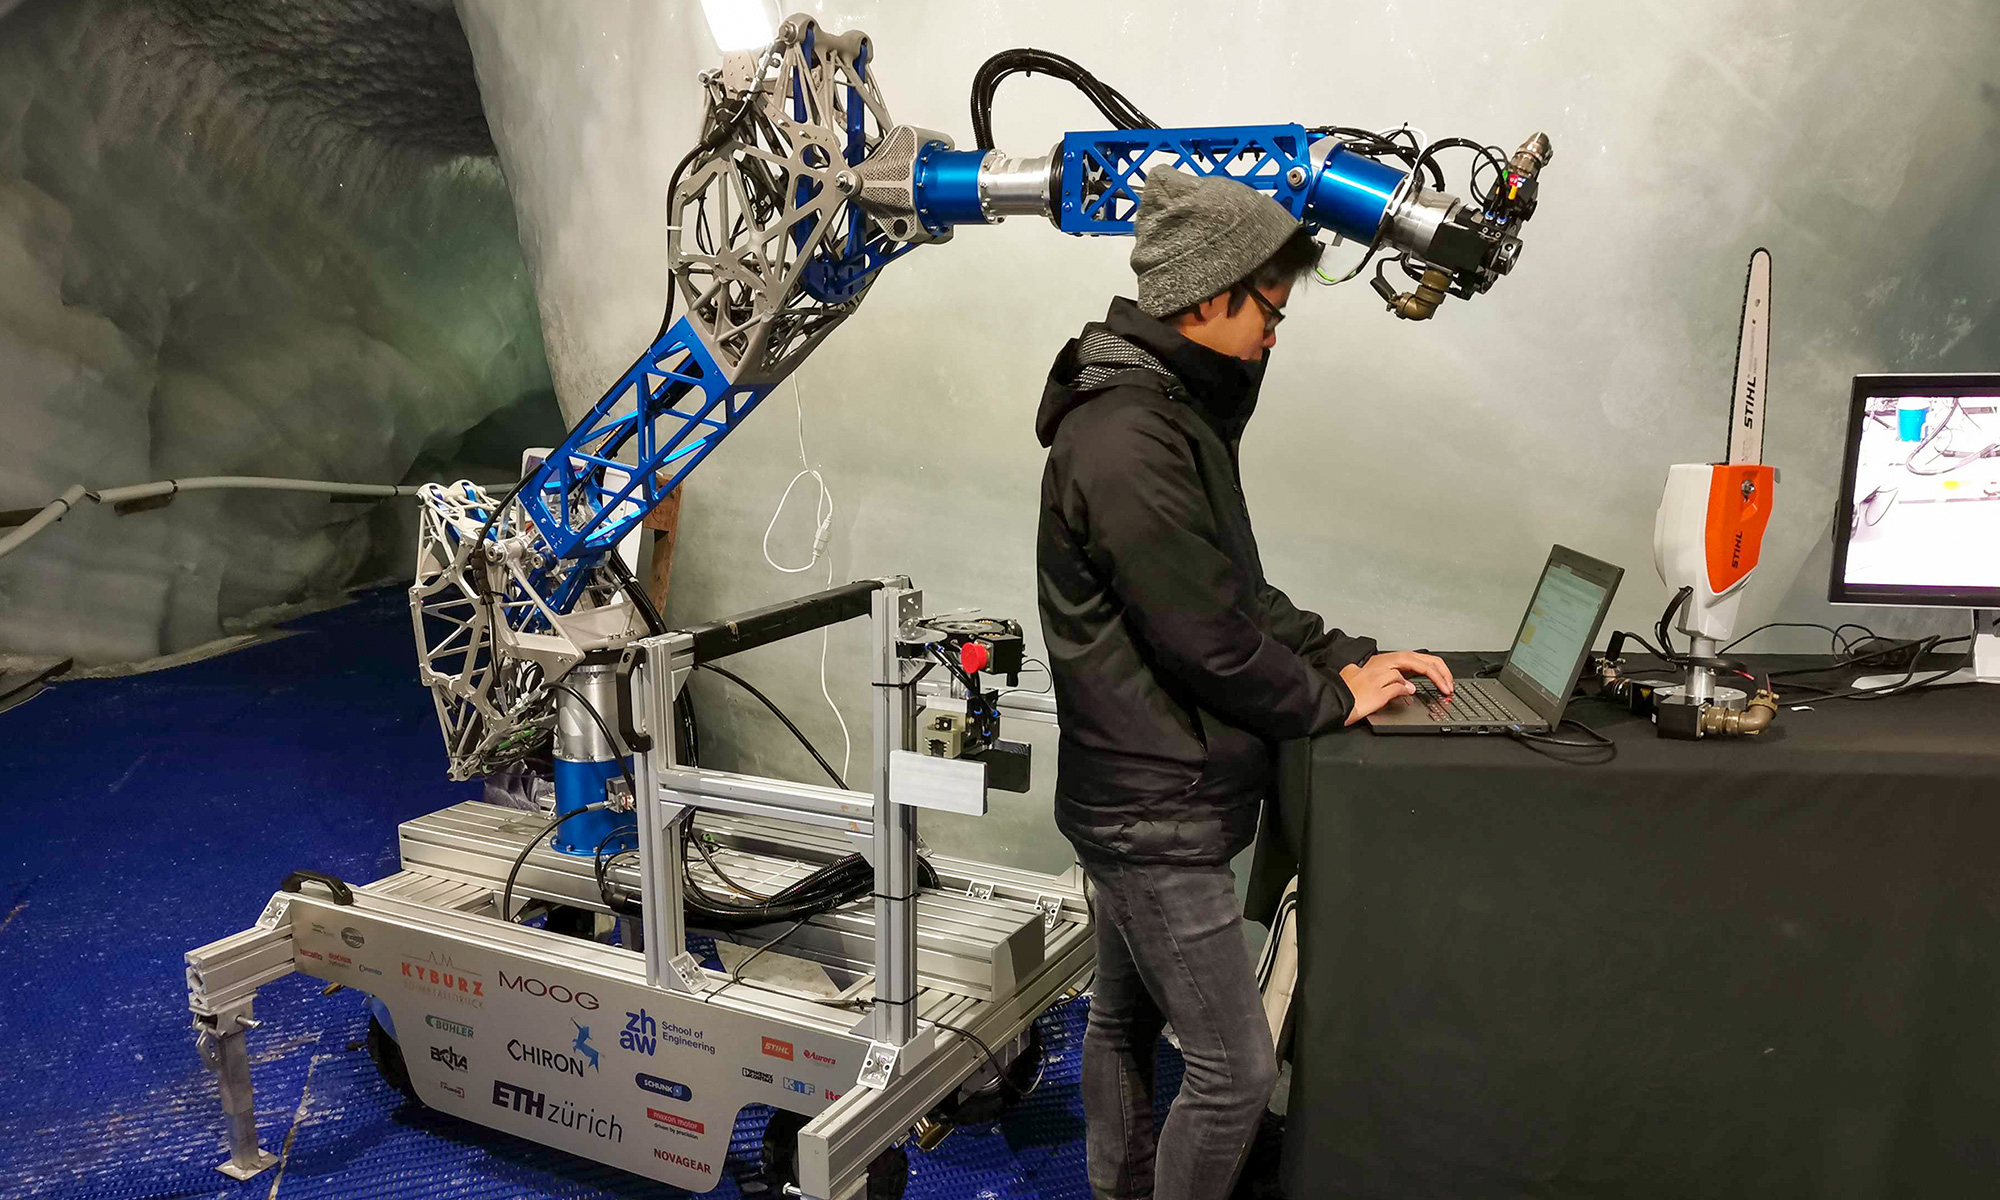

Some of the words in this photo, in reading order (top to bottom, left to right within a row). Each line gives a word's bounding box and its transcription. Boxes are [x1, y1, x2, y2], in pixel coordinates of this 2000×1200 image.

[1744, 376, 1756, 429] STIHL
[1732, 531, 1743, 569] STIHL
[401, 962, 484, 996] KYBURZ
[499, 970, 600, 1010] MOOG
[661, 1021, 692, 1036] School
[694, 1031, 703, 1039] of
[662, 1032, 715, 1055] Engineering
[764, 1042, 790, 1055] STIHL
[507, 1039, 584, 1078] CHIRON
[807, 1051, 836, 1065] Aurora
[644, 1079, 673, 1093] SCHUNK
[824, 1089, 842, 1101] ite
[653, 1112, 677, 1124] maxon
[677, 1117, 697, 1129] motor
[654, 1148, 711, 1174] NOVAGEAR
